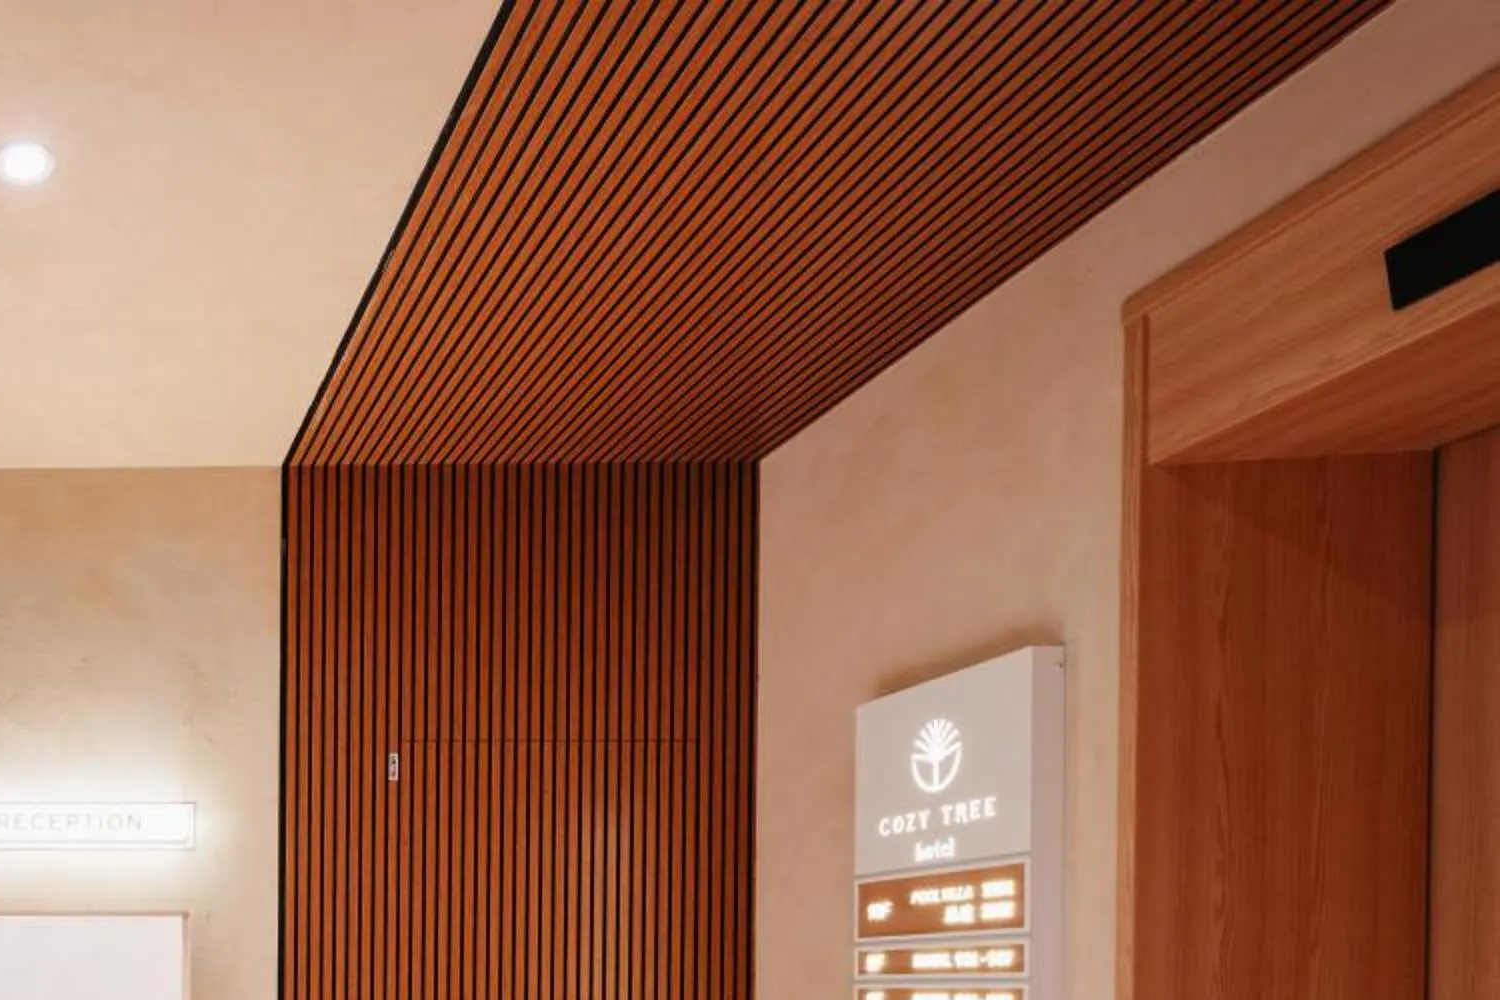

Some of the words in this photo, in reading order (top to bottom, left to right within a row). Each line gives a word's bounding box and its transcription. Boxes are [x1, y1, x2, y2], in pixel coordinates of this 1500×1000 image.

[878, 808, 931, 837] COZY
[941, 796, 997, 826] TREE
[914, 835, 956, 863] hotel
